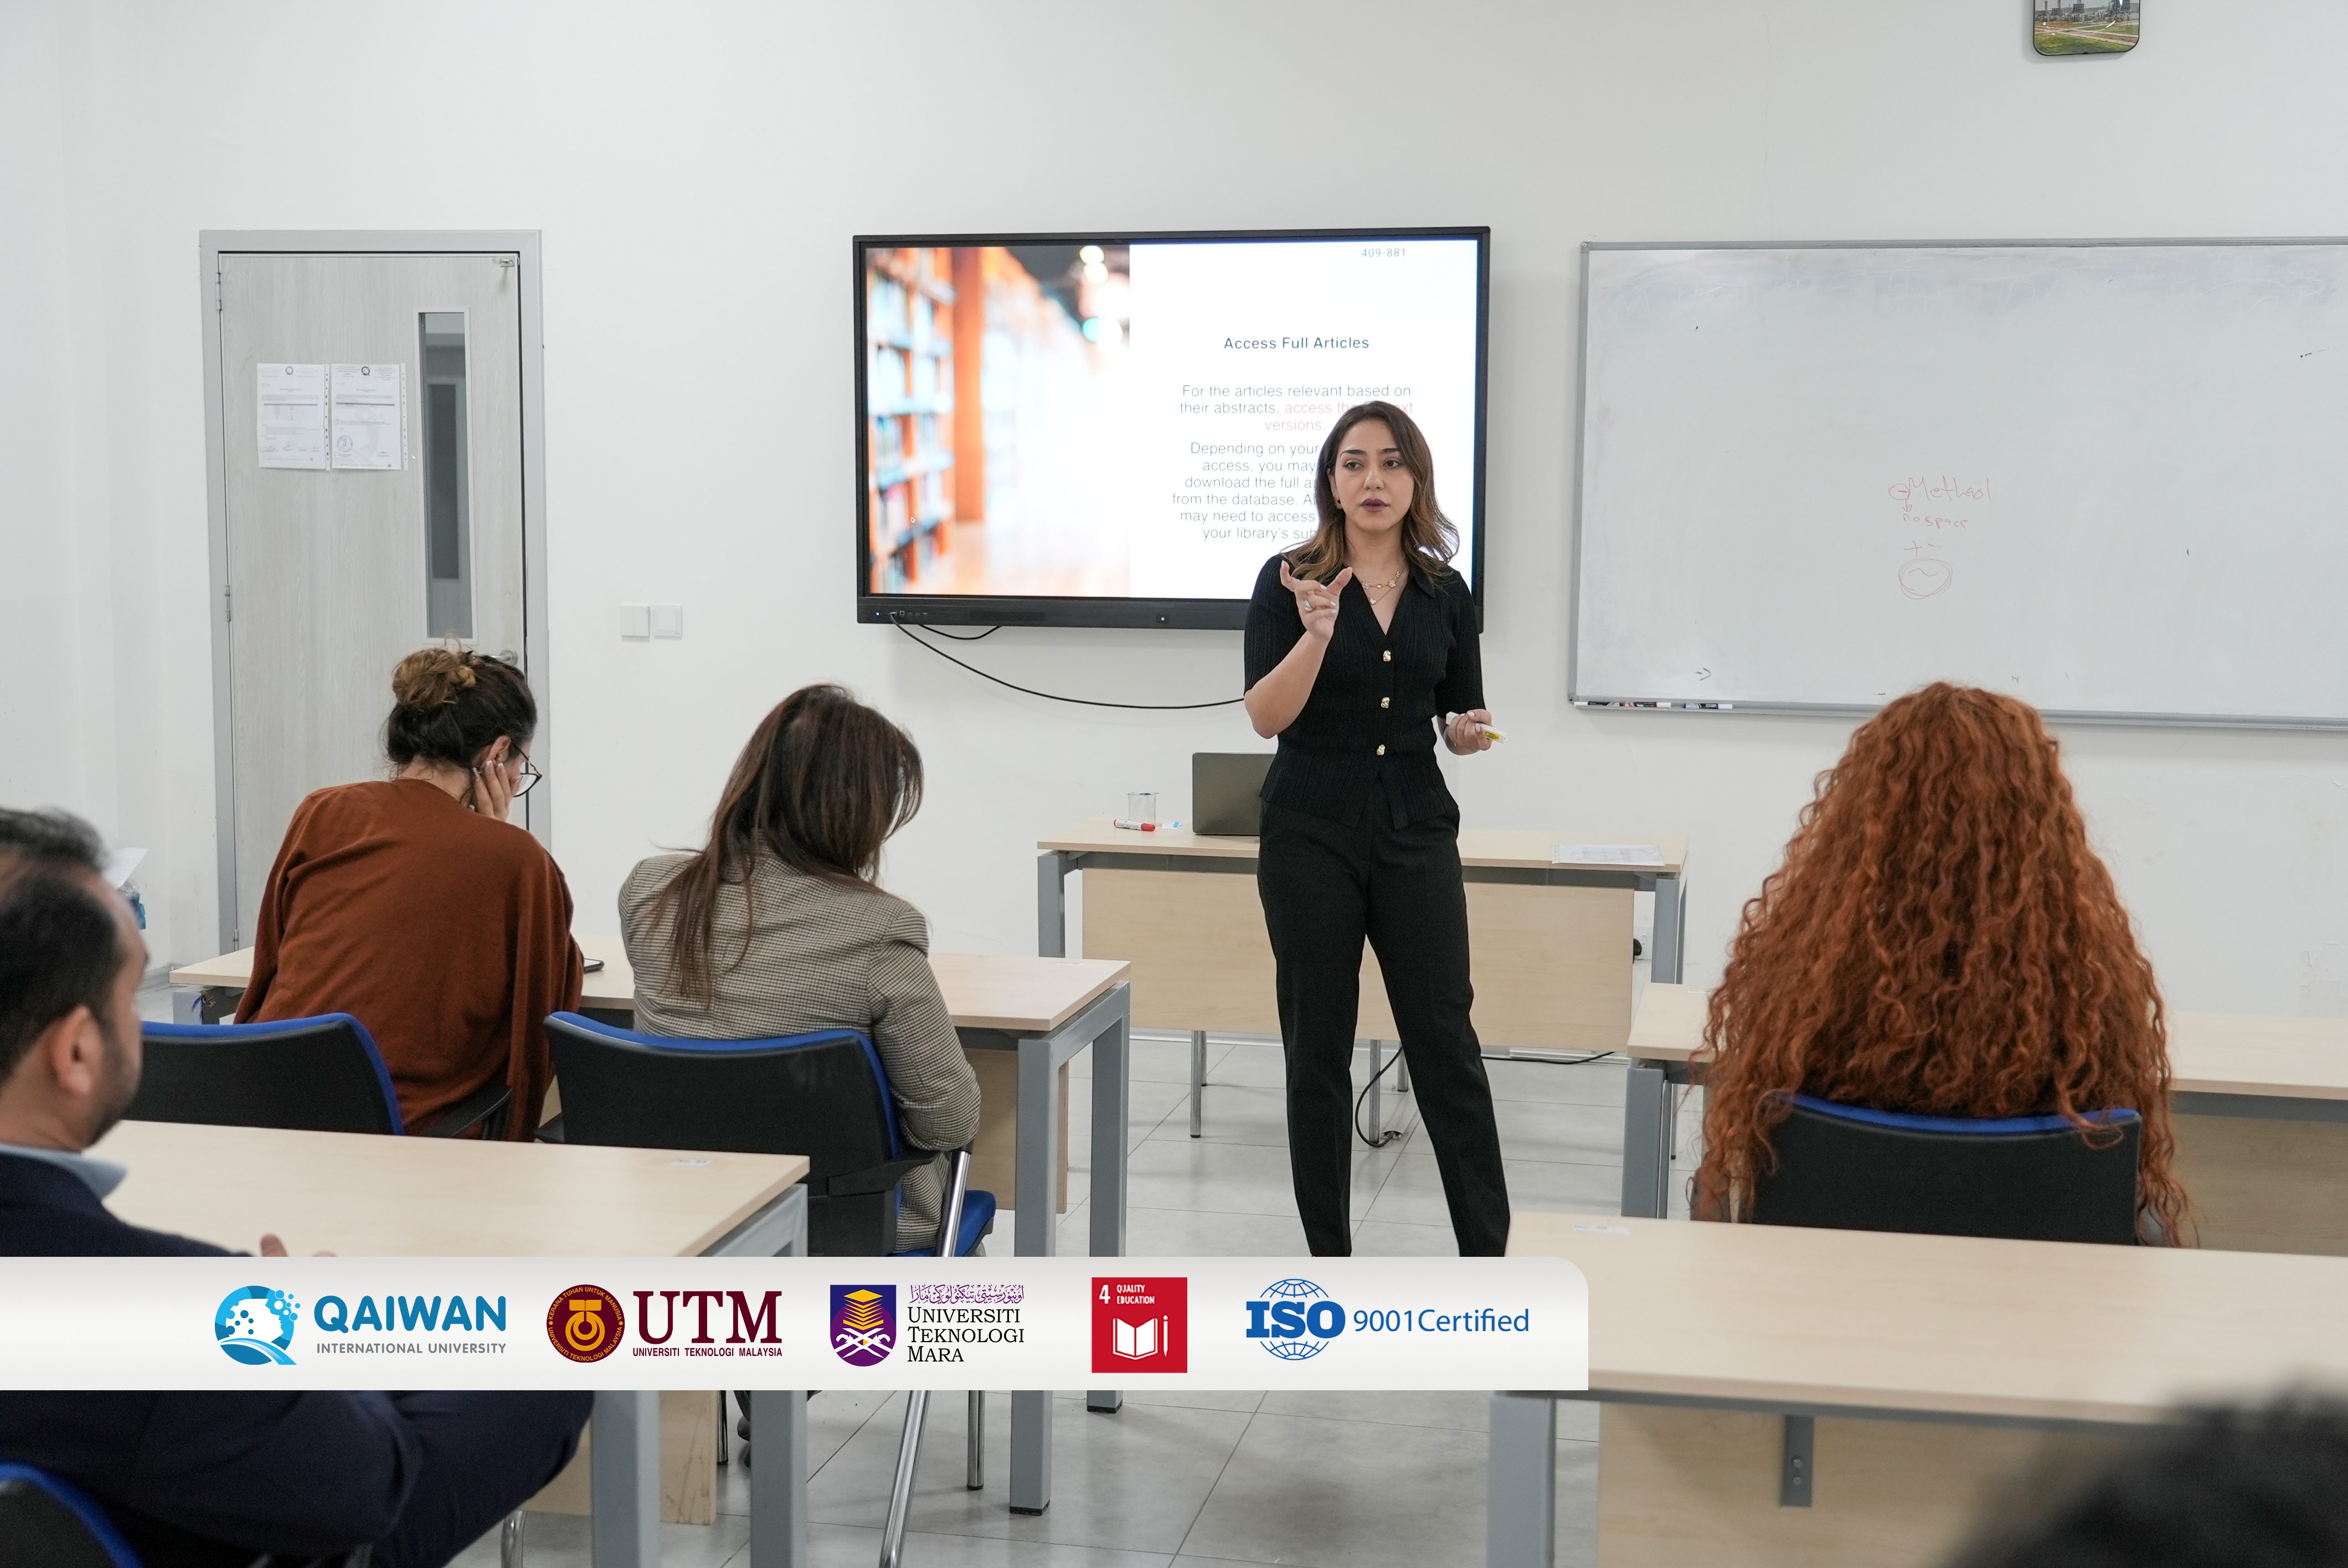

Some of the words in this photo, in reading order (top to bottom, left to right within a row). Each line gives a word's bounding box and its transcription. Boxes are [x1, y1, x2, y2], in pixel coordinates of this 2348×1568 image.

[1362, 248, 1404, 257] 409-881
[1224, 338, 1276, 349] Access
[1283, 337, 1307, 349] Full
[1314, 337, 1369, 349] Articles
[1183, 385, 1204, 396] For
[1210, 385, 1229, 396] the
[1235, 385, 1282, 396] articles
[1288, 385, 1342, 396] relevant
[1347, 385, 1389, 396] based
[1394, 387, 1410, 396] on
[1180, 402, 1208, 414] their
[1214, 401, 1279, 414] abstracts,
[1285, 404, 1332, 414] access
[1265, 419, 1325, 431] versions.
[1191, 442, 1263, 457] Depending
[1268, 445, 1285, 454] on
[1290, 445, 1320, 457] your
[1203, 462, 1253, 472] access,
[1259, 462, 1282, 474] you
[1288, 462, 1316, 474] may
[1185, 476, 1249, 488] download
[1255, 476, 1275, 488] the
[1280, 476, 1299, 488] full
[1172, 492, 1202, 504] from
[1207, 493, 1227, 505] the
[1232, 493, 1298, 505] database.
[1181, 512, 1208, 525] may
[1213, 510, 1246, 522] need
[1252, 510, 1263, 522] to
[1268, 513, 1315, 522] access
[1203, 529, 1232, 541] your
[1237, 527, 1288, 541] library's
